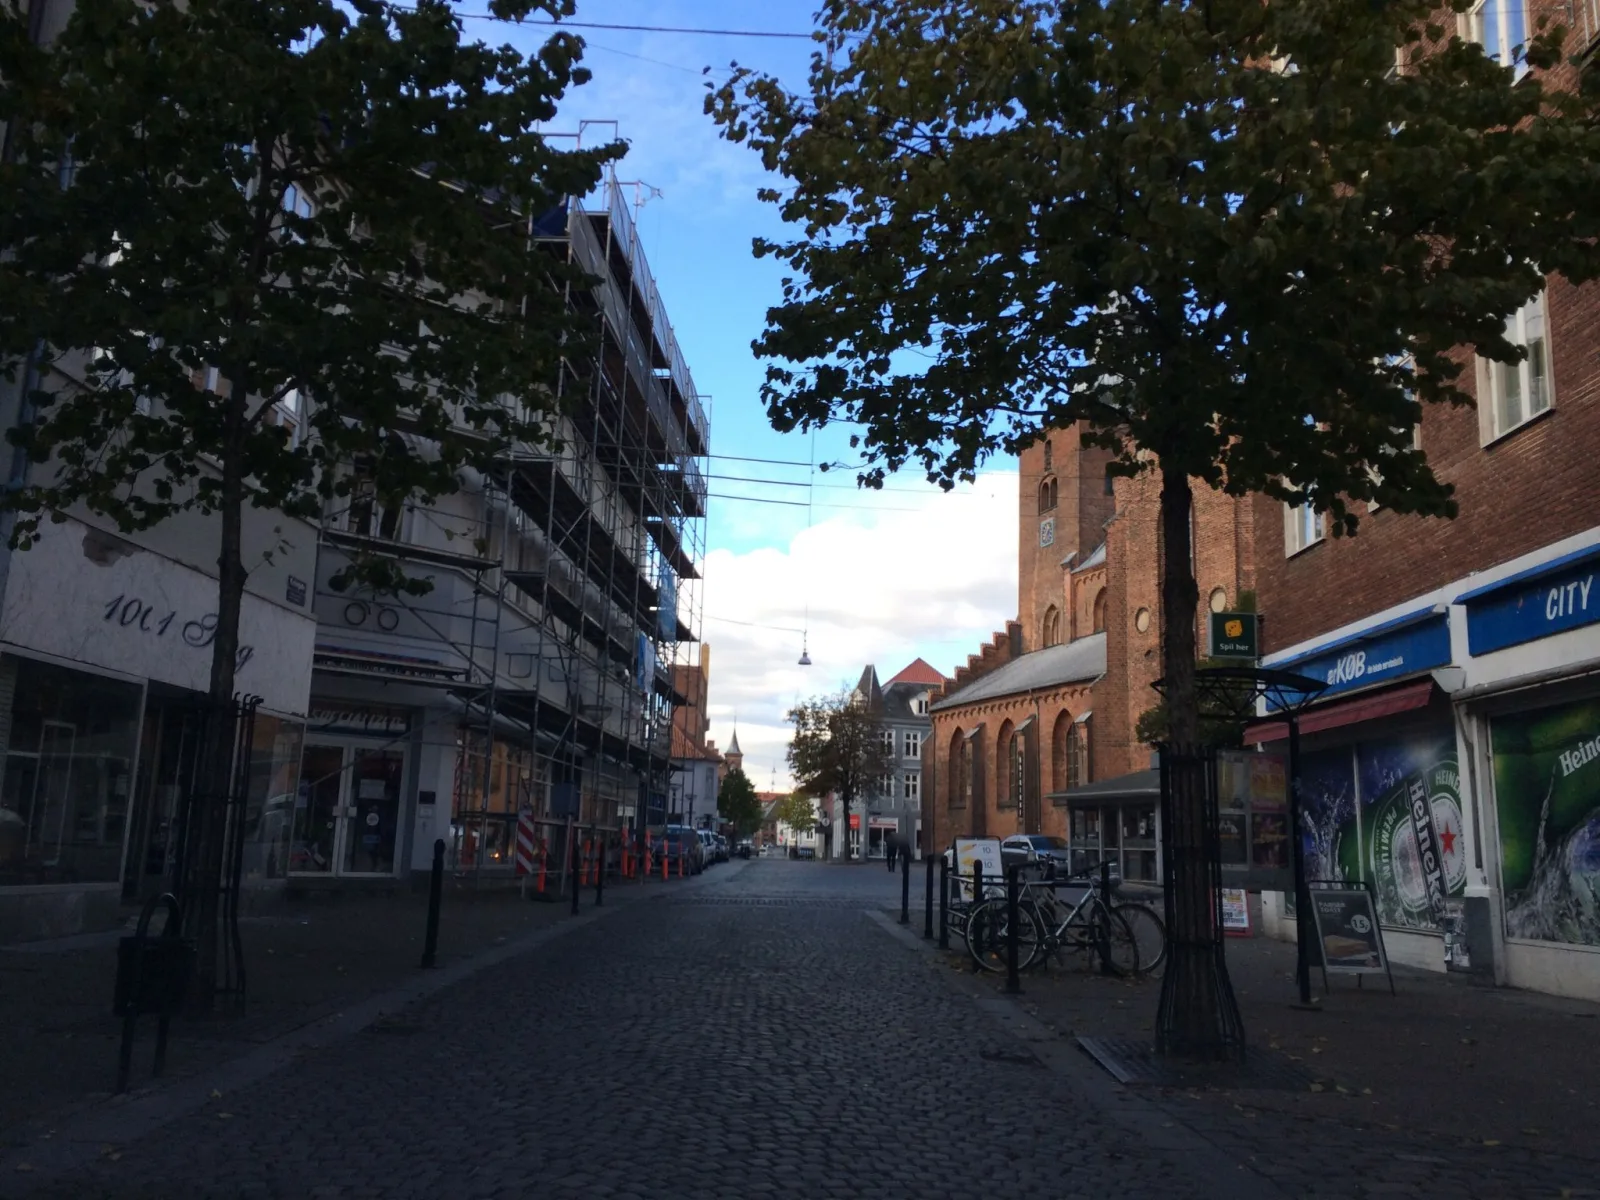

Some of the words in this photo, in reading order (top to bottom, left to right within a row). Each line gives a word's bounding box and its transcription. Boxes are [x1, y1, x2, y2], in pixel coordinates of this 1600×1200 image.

[1546, 575, 1594, 620] CITY
[1219, 643, 1234, 651] Spil
[1235, 643, 1249, 651] her
[1409, 779, 1445, 924] Heineke
